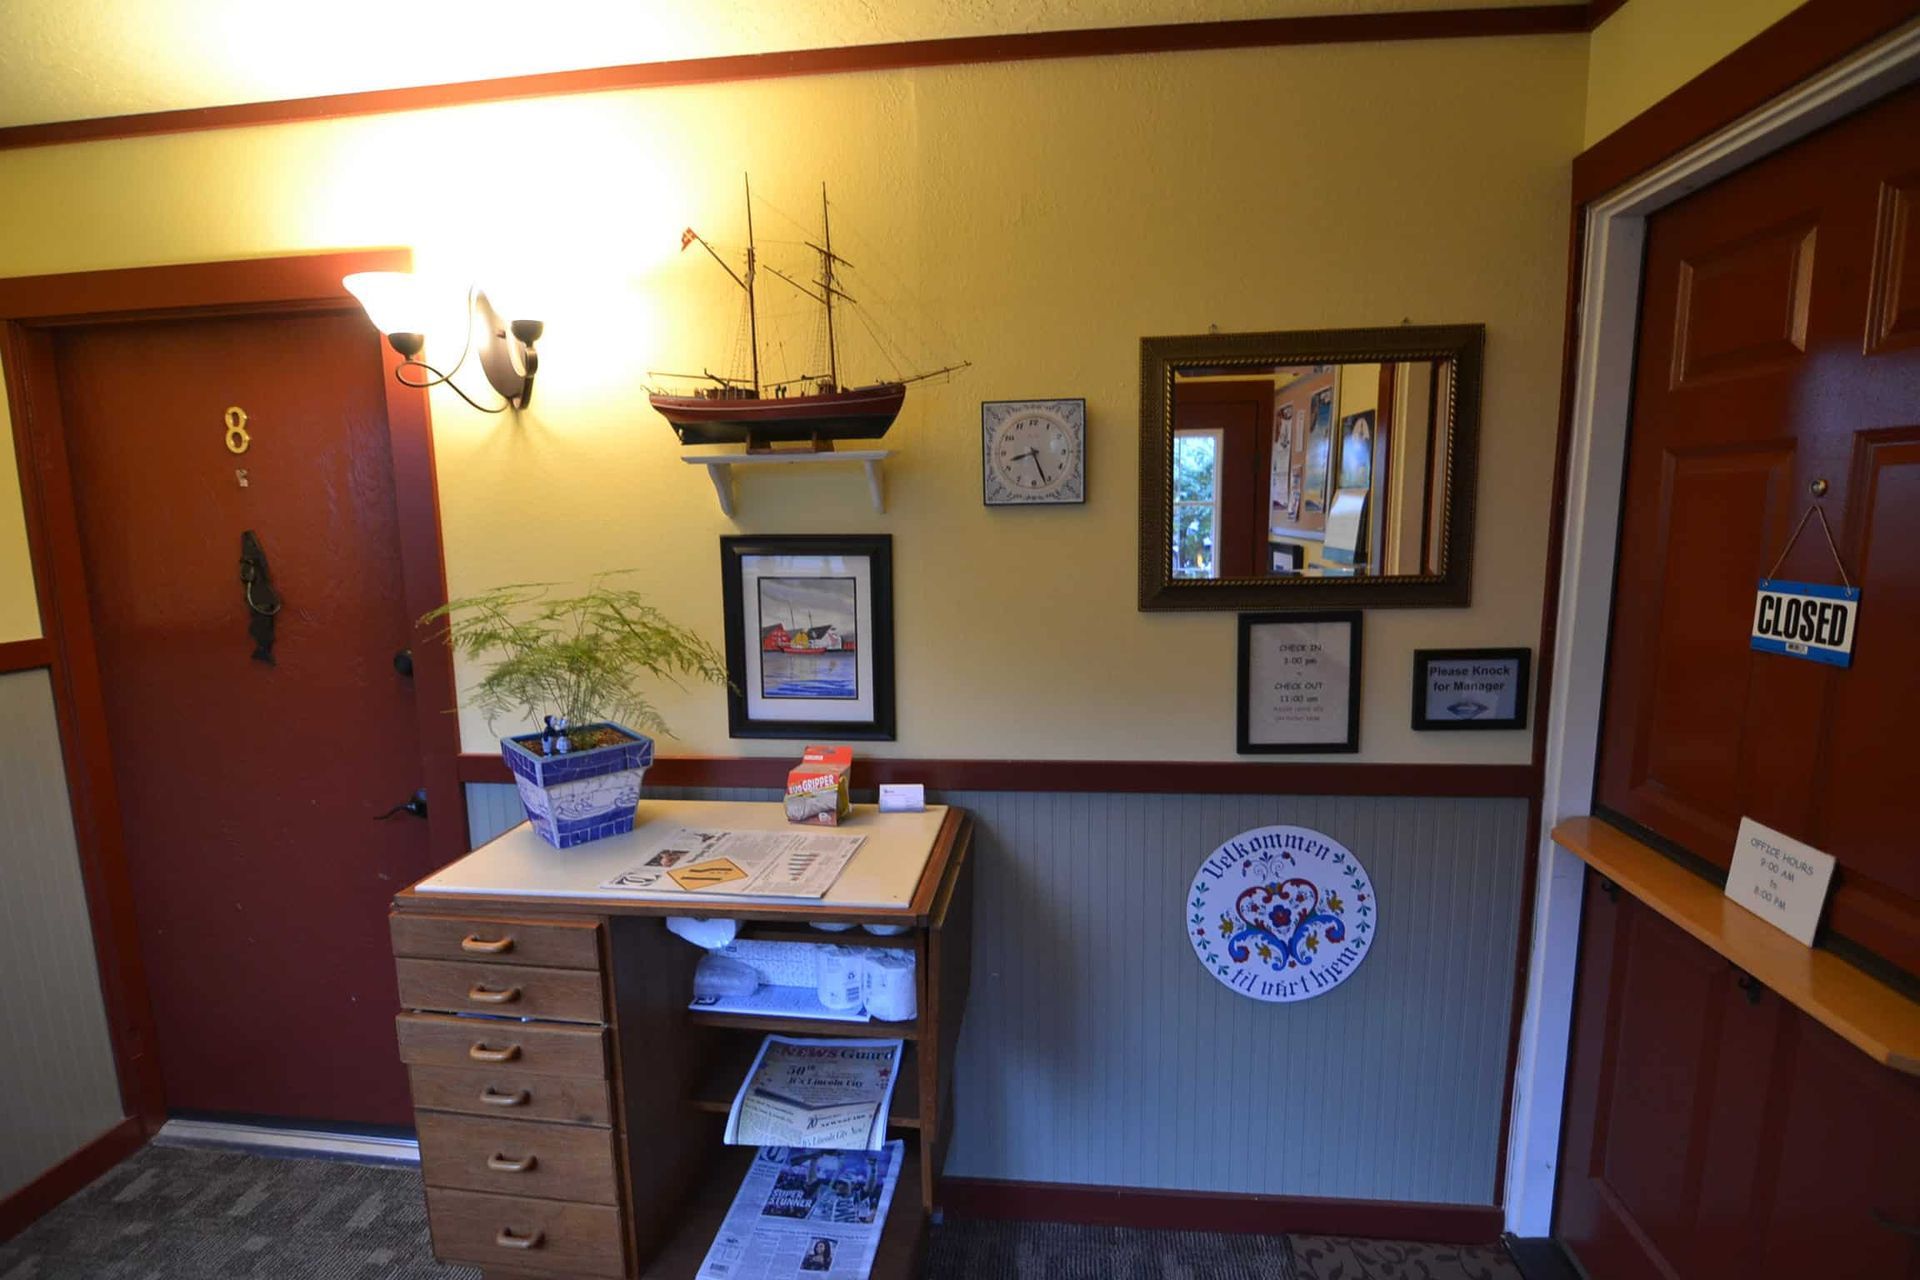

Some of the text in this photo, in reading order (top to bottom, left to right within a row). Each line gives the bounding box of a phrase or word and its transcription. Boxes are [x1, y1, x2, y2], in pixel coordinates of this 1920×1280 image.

[225, 406, 250, 454] 8
[1757, 594, 1848, 646] CLOSED
[1279, 644, 1322, 652] CHECK IN
[1429, 665, 1511, 676] Please Knock
[1274, 681, 1322, 690] CHECK OUT
[1433, 681, 1505, 693] for Manager
[1750, 838, 1814, 876] OFFICE HOURS
[1760, 858, 1794, 882] 9:00 AM
[773, 1189, 804, 1199] SUPER
[768, 1196, 812, 1208] STUNNER
